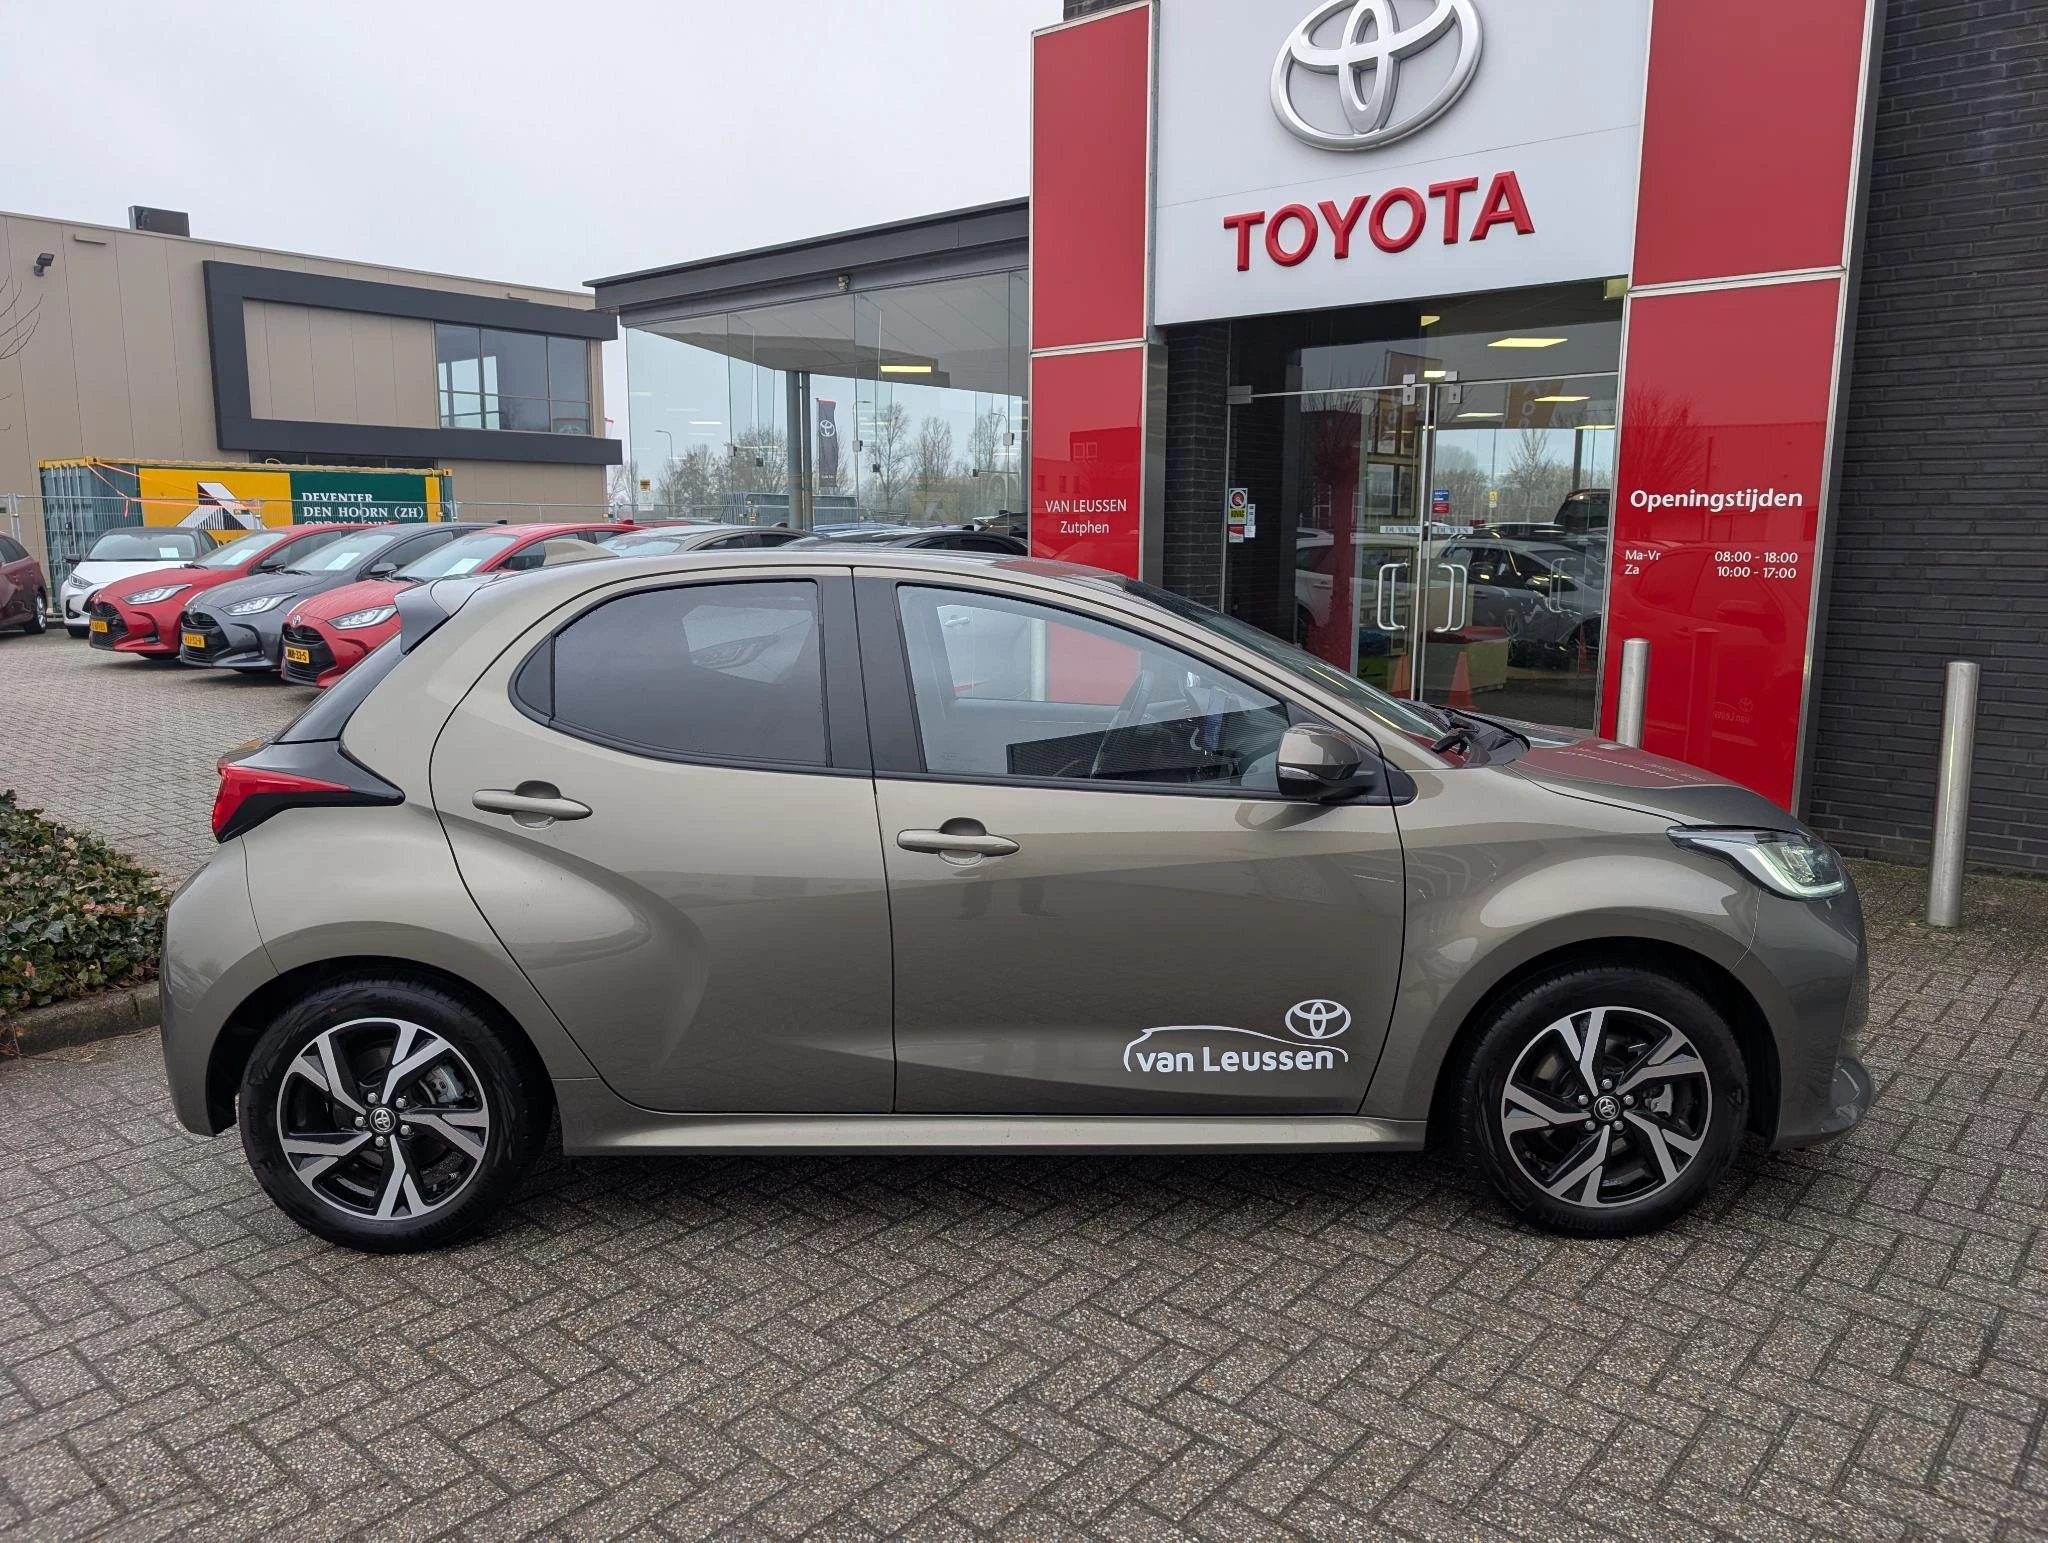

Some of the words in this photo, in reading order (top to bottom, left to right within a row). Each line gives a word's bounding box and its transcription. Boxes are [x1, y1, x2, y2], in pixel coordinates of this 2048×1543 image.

[1223, 171, 1535, 272] TOYOTA
[302, 492, 373, 502] DEVENTER
[1630, 488, 1803, 512] Openingstijden
[303, 506, 332, 517] DEN
[338, 507, 388, 518] HOORN
[394, 506, 424, 519] (ZH)
[1045, 500, 1070, 513] VAN
[1073, 499, 1127, 512] LEUSSEN
[1060, 520, 1109, 536] Zutphen
[1625, 549, 1661, 561] Ma-Vr
[1714, 551, 1751, 563] 08:00
[1763, 552, 1798, 564] 18:00
[1624, 564, 1640, 575] Za
[1716, 566, 1750, 578] 10:00
[1762, 567, 1797, 579] 17:00
[1136, 1051, 1194, 1072] van
[1202, 1046, 1334, 1072] Leussen
